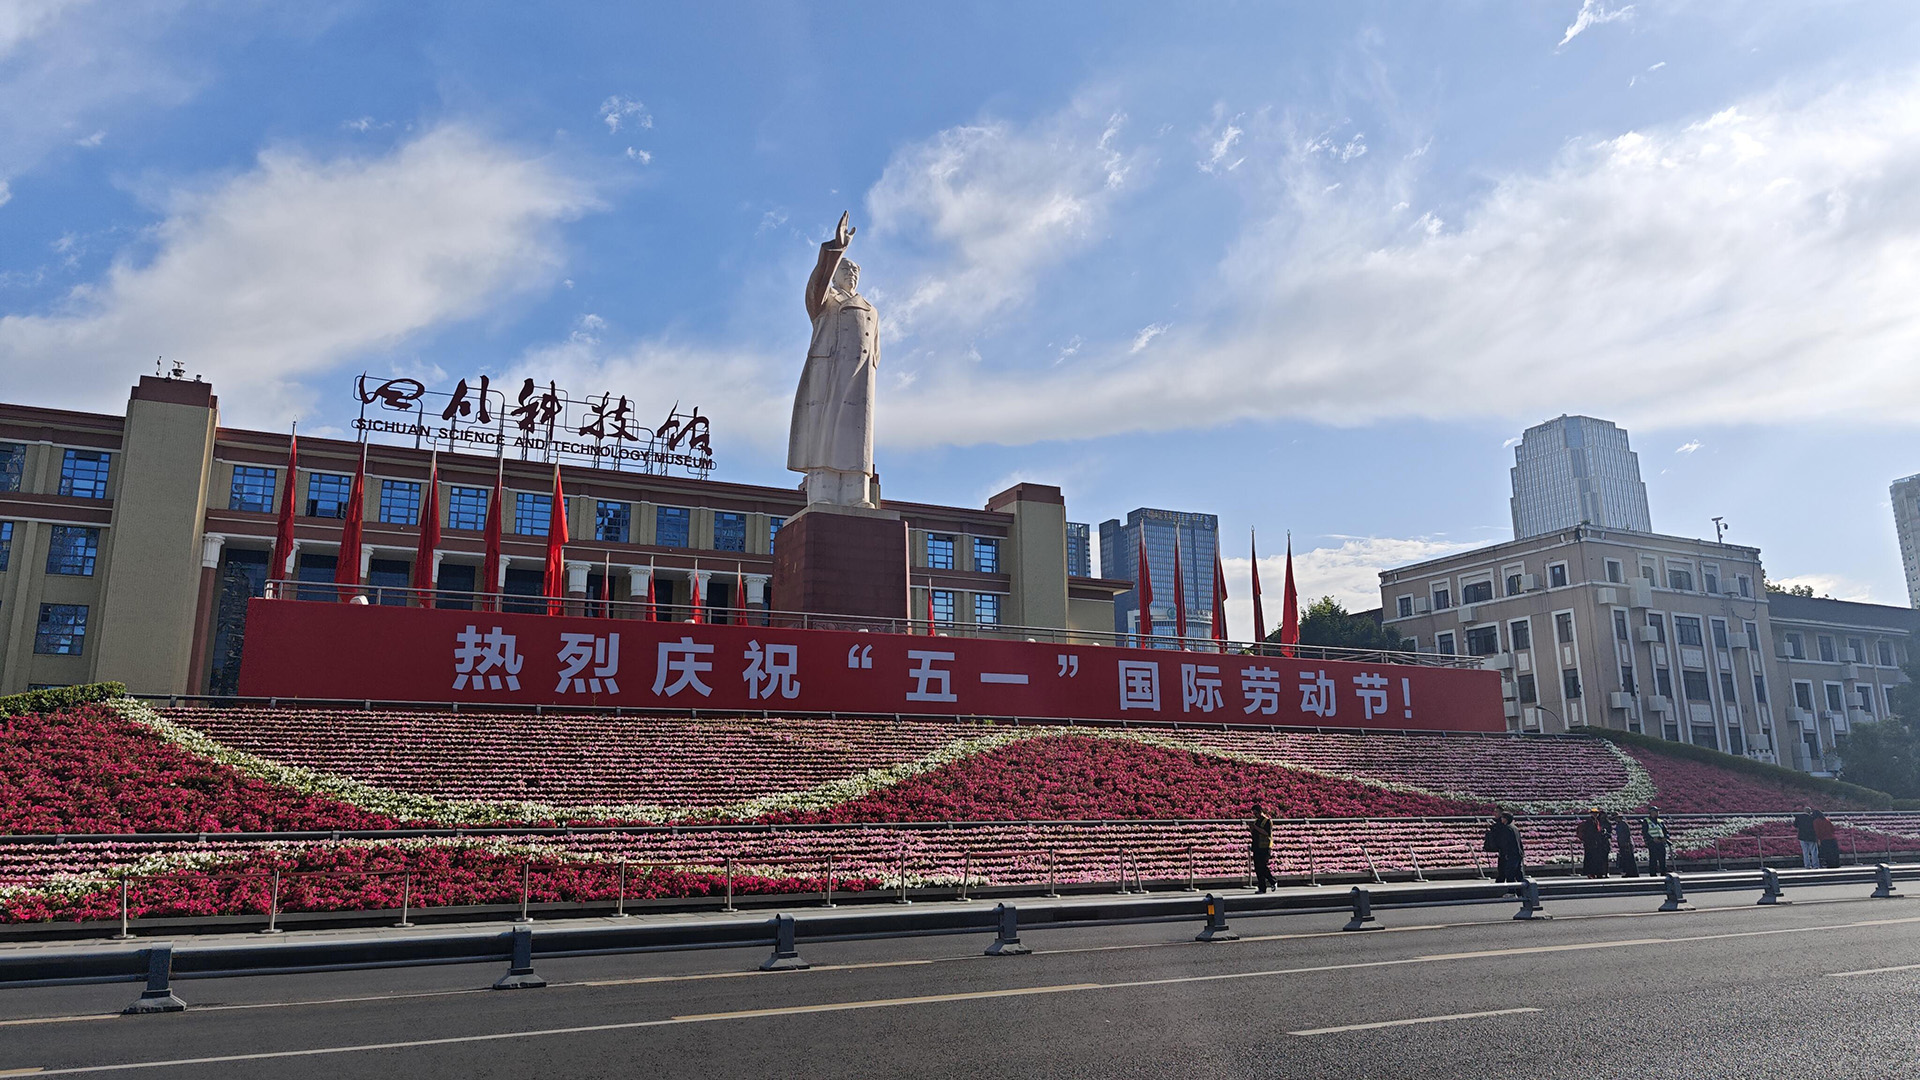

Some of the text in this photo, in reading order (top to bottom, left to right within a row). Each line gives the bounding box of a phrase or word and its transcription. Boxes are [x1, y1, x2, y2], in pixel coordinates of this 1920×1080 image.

[356, 417, 713, 470] SICHUAN SCIENCE AND TECHNOLOGY MUSEUM
[358, 370, 713, 455] 四川科技馆
